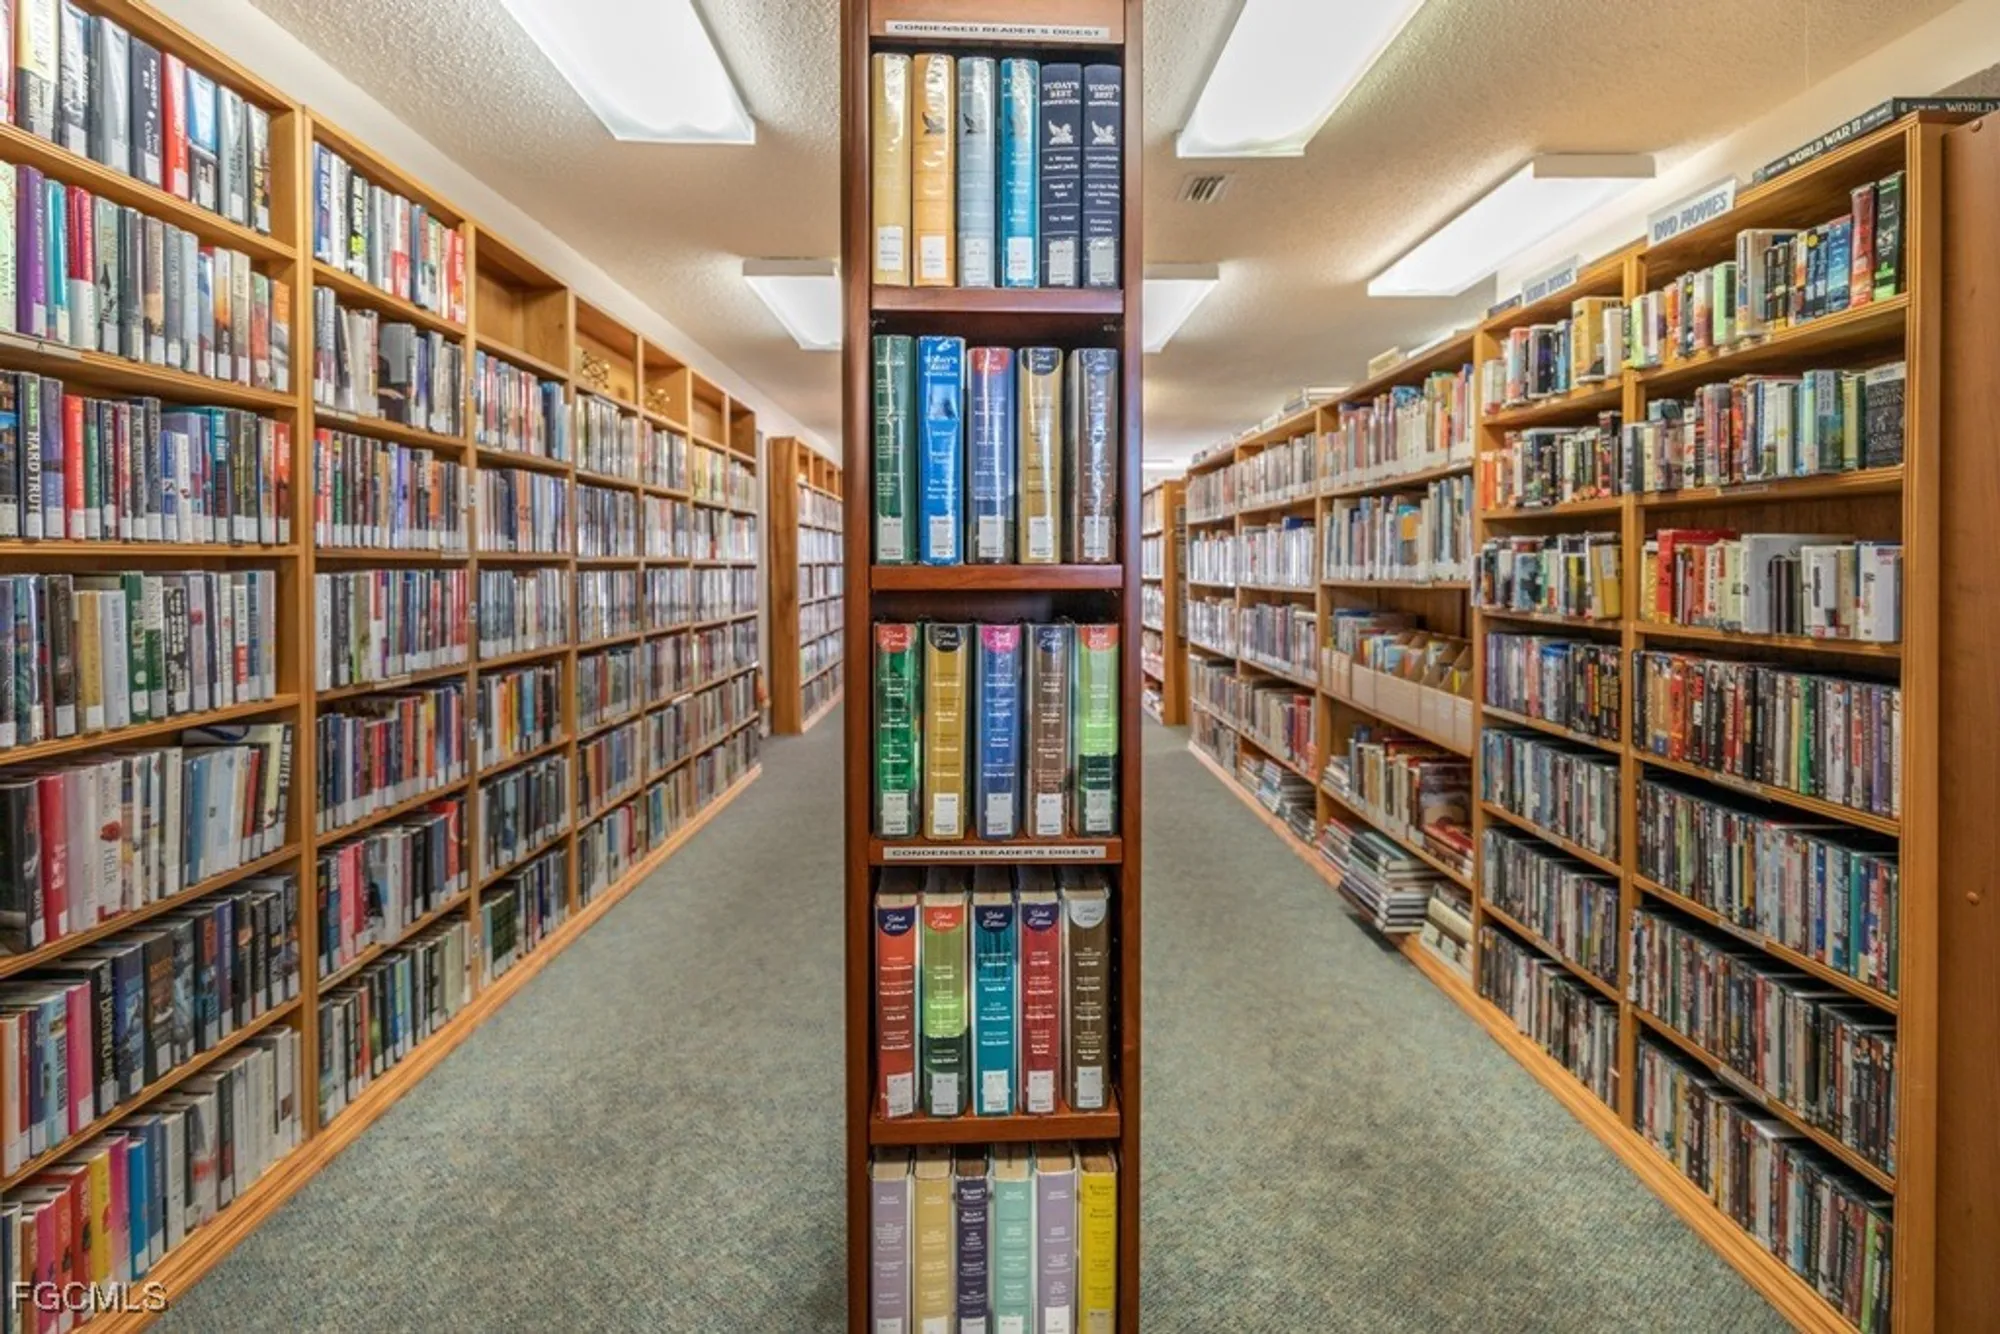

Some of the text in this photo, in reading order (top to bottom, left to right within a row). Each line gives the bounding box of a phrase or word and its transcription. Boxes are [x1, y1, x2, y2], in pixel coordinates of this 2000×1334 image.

[894, 24, 979, 33] CONDENSED
[1052, 28, 1100, 37] DIGEST
[1945, 101, 1995, 112] WORLD
[1788, 140, 1824, 165] WORLD
[1824, 126, 1852, 147] WAR
[1653, 191, 1729, 242] DVD MOVIES
[27, 431, 42, 517] HARD TRUT
[892, 849, 976, 857] CONDENSED
[1048, 848, 1097, 856] DIGEST
